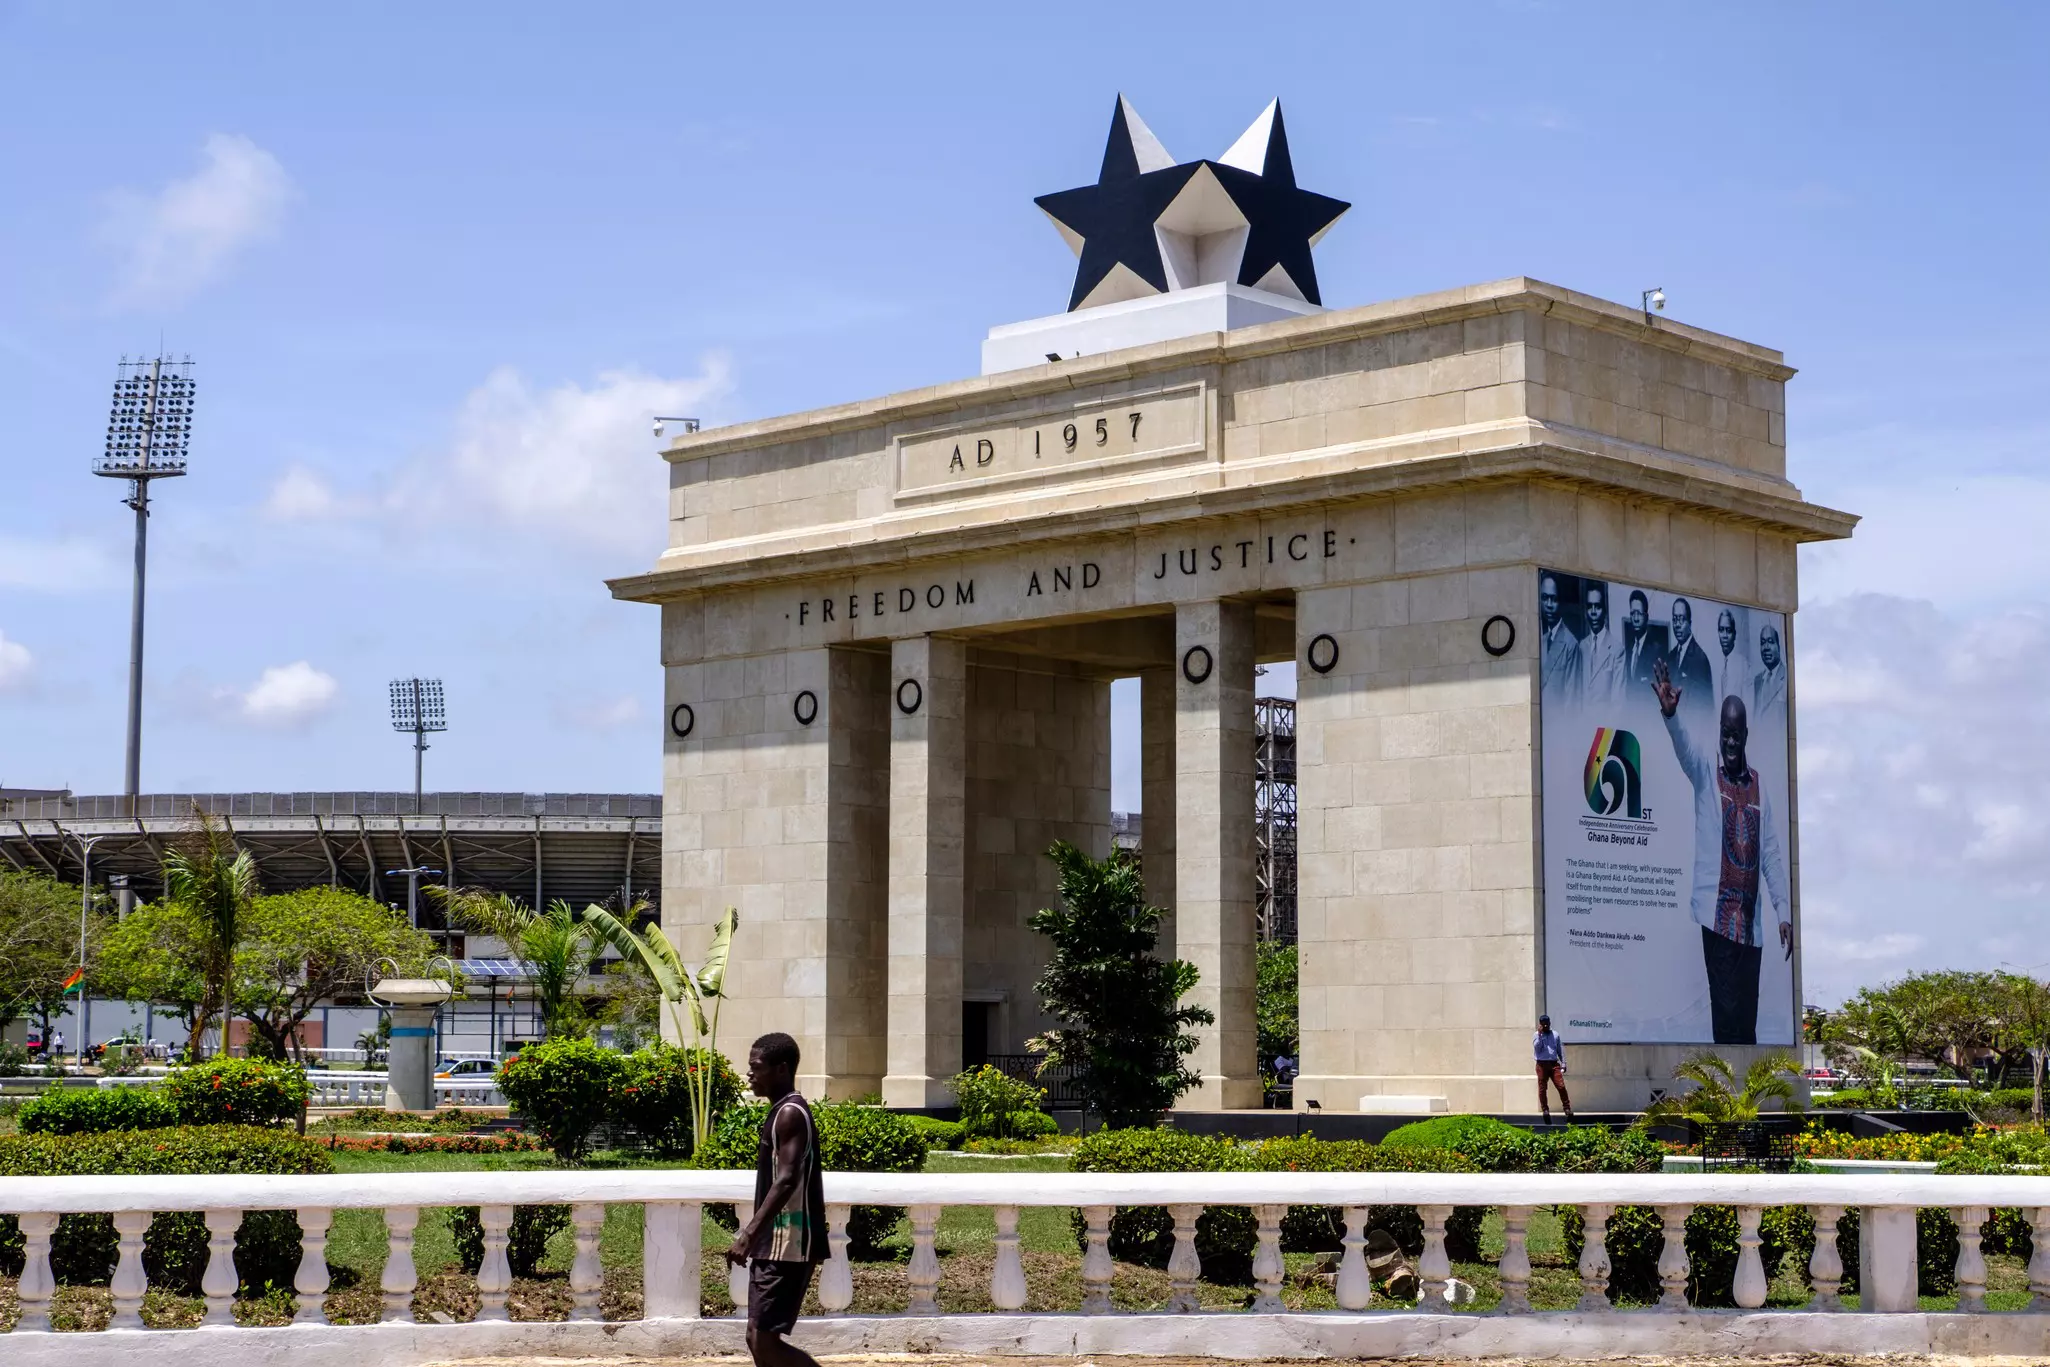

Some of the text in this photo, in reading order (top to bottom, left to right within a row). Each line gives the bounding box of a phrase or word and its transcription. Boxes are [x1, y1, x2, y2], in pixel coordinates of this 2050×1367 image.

[949, 412, 1142, 469] AD 1957
[1027, 563, 1101, 597] AND
[1579, 819, 1658, 832] Independence Anniversary Celebration
[1587, 831, 1648, 846] Ghana Beyond Aid
[1578, 859, 1594, 868] Ghana
[1596, 861, 1606, 869] that
[1640, 864, 1650, 872] with
[1651, 866, 1662, 874] your
[1575, 871, 1592, 880] Ghana
[1592, 872, 1611, 882] Beyond
[1664, 877, 1674, 886] free
[1580, 883, 1592, 891] from
[1660, 888, 1676, 896] Ghana
[1570, 929, 1582, 937] Nana
[1583, 930, 1596, 938] Addo
[1596, 930, 1616, 939] Dankwa
[1570, 939, 1590, 948] President
[1605, 942, 1624, 950] Republic
